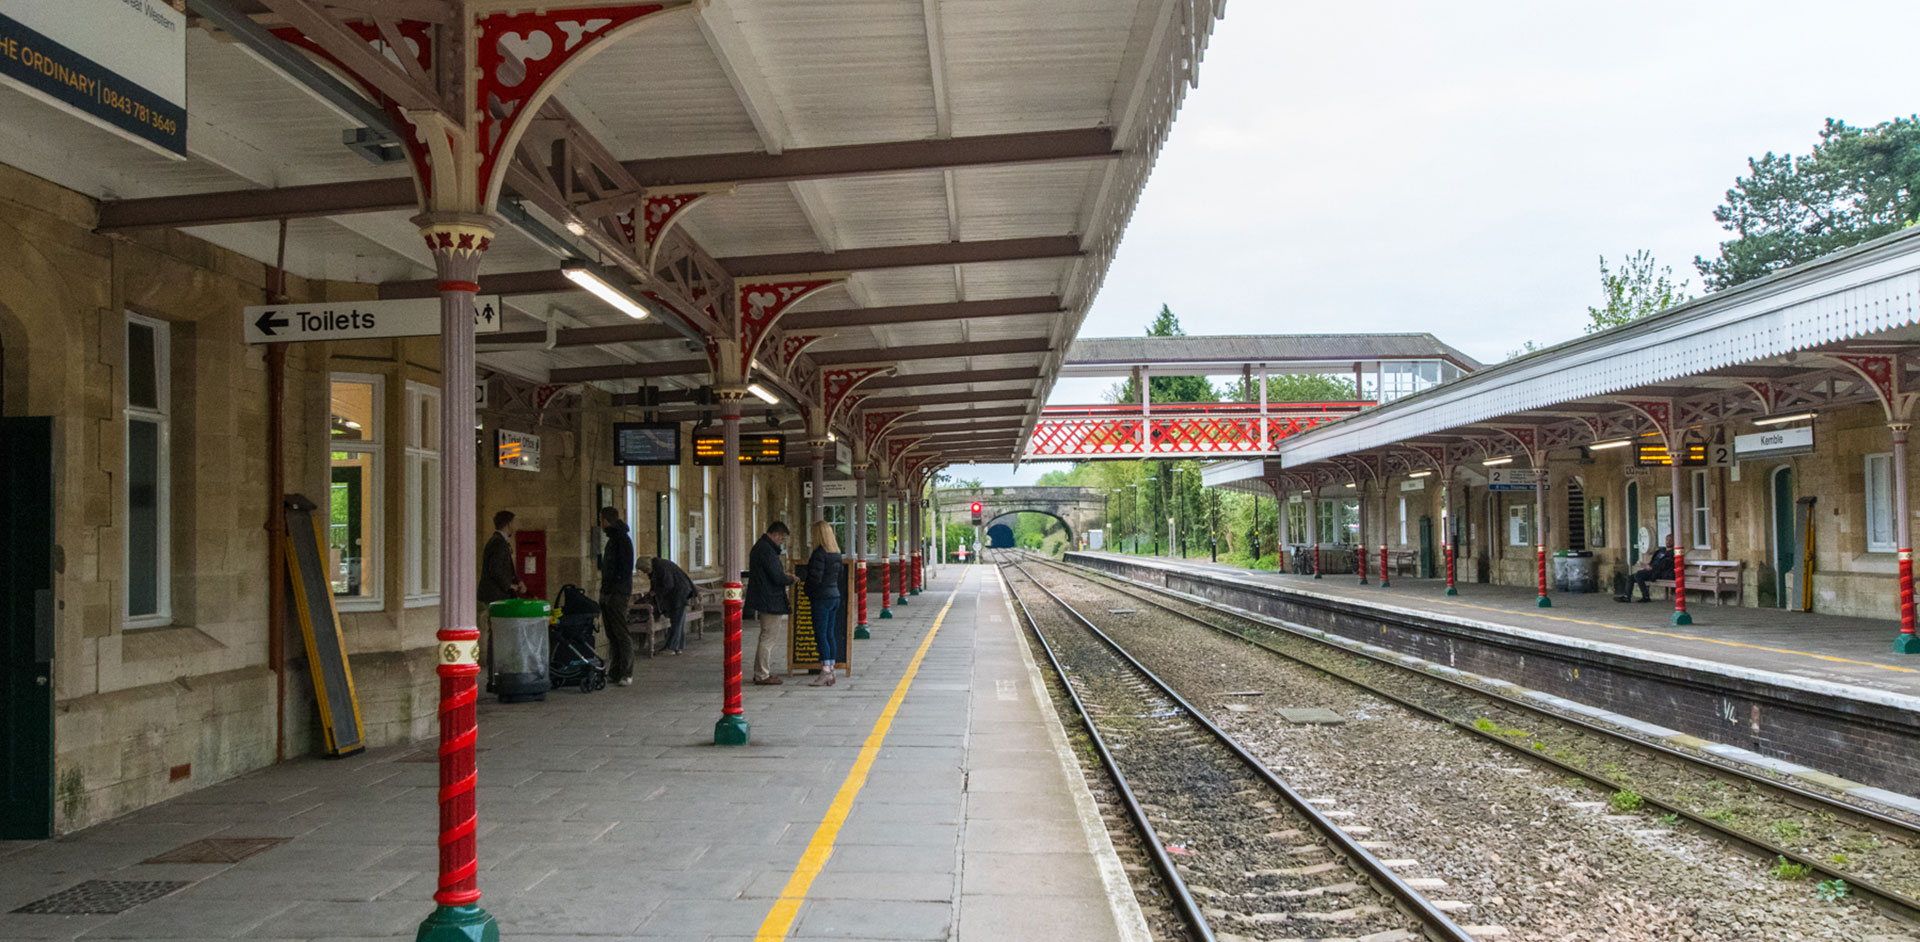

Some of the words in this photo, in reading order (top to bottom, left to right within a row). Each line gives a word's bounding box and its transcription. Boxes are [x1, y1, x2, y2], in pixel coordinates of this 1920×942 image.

[145, 1, 175, 32] Western
[21, 46, 96, 97] ORDINARY
[103, 87, 131, 116] 0843
[134, 101, 149, 125] 781
[152, 111, 176, 136] 3649
[296, 309, 376, 332] Toilets
[523, 437, 534, 448] Office
[1760, 434, 1784, 446] Kemble
[1716, 448, 1728, 463] 2
[1493, 471, 1501, 482] 2
